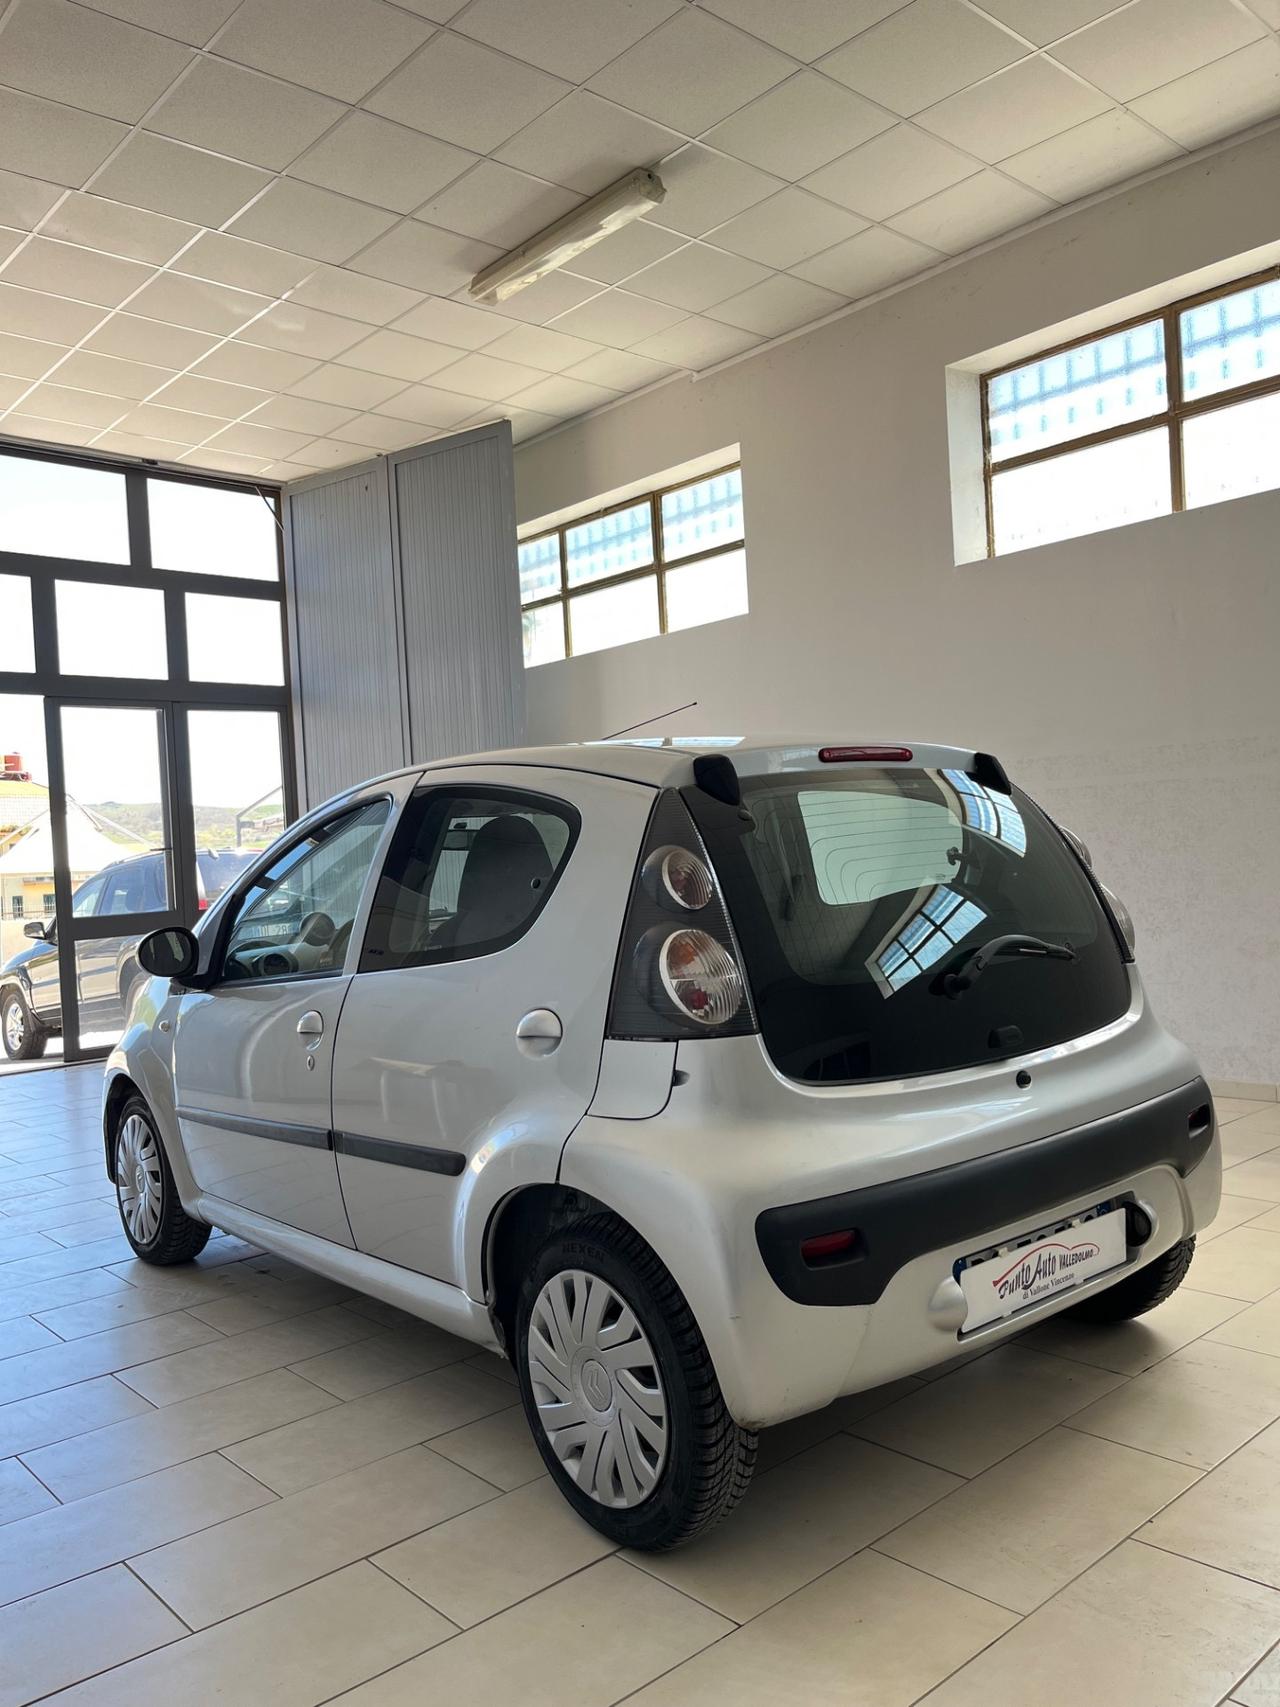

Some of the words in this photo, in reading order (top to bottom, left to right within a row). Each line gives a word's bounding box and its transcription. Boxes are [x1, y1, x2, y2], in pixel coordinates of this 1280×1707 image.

[562, 1242, 605, 1264] NEXEN
[998, 1262, 1031, 1300] Punto
[1022, 1252, 1057, 1290] Auto
[1059, 1249, 1093, 1271] VALLEDOLMO
[1022, 1292, 1029, 1300] di
[1029, 1284, 1050, 1296] Vallone
[1050, 1273, 1075, 1288] Vincenzo
